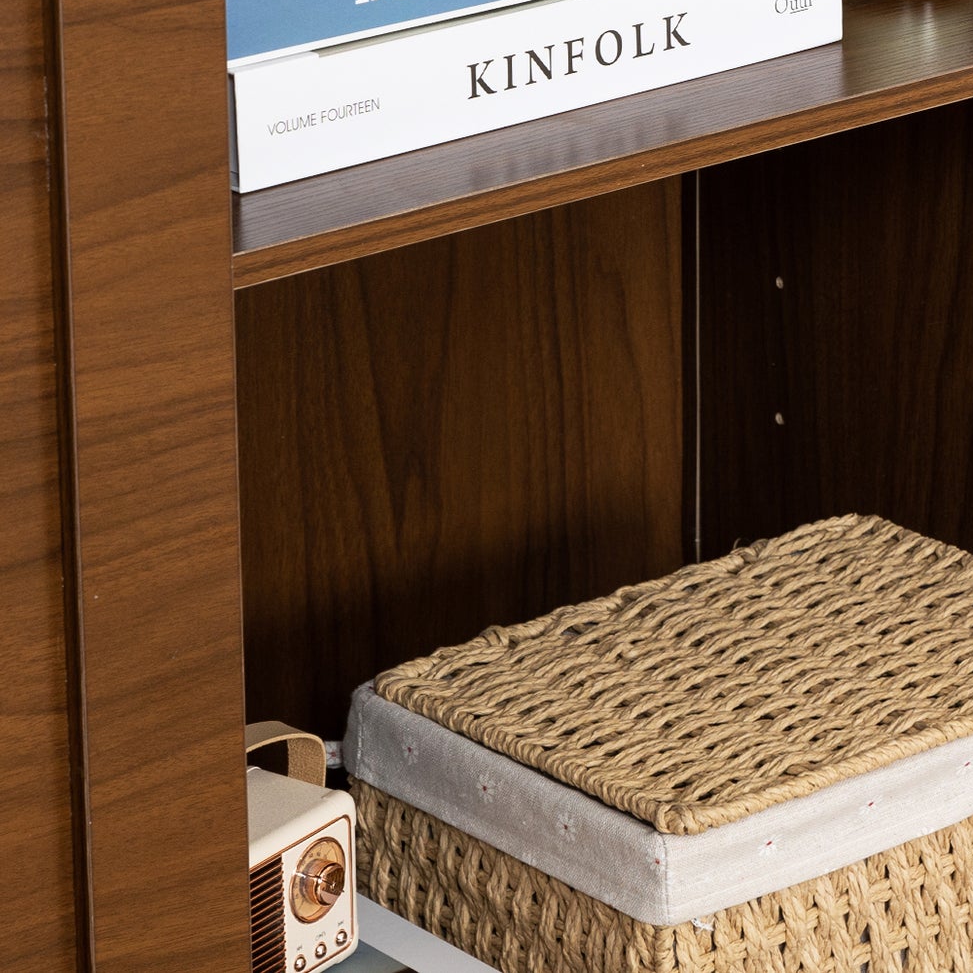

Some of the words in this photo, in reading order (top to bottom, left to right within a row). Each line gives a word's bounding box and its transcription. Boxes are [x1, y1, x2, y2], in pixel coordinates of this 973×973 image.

[466, 11, 691, 100] KINFOLK
[267, 113, 317, 135] VOLUME
[320, 98, 380, 124] FOURTEEN
